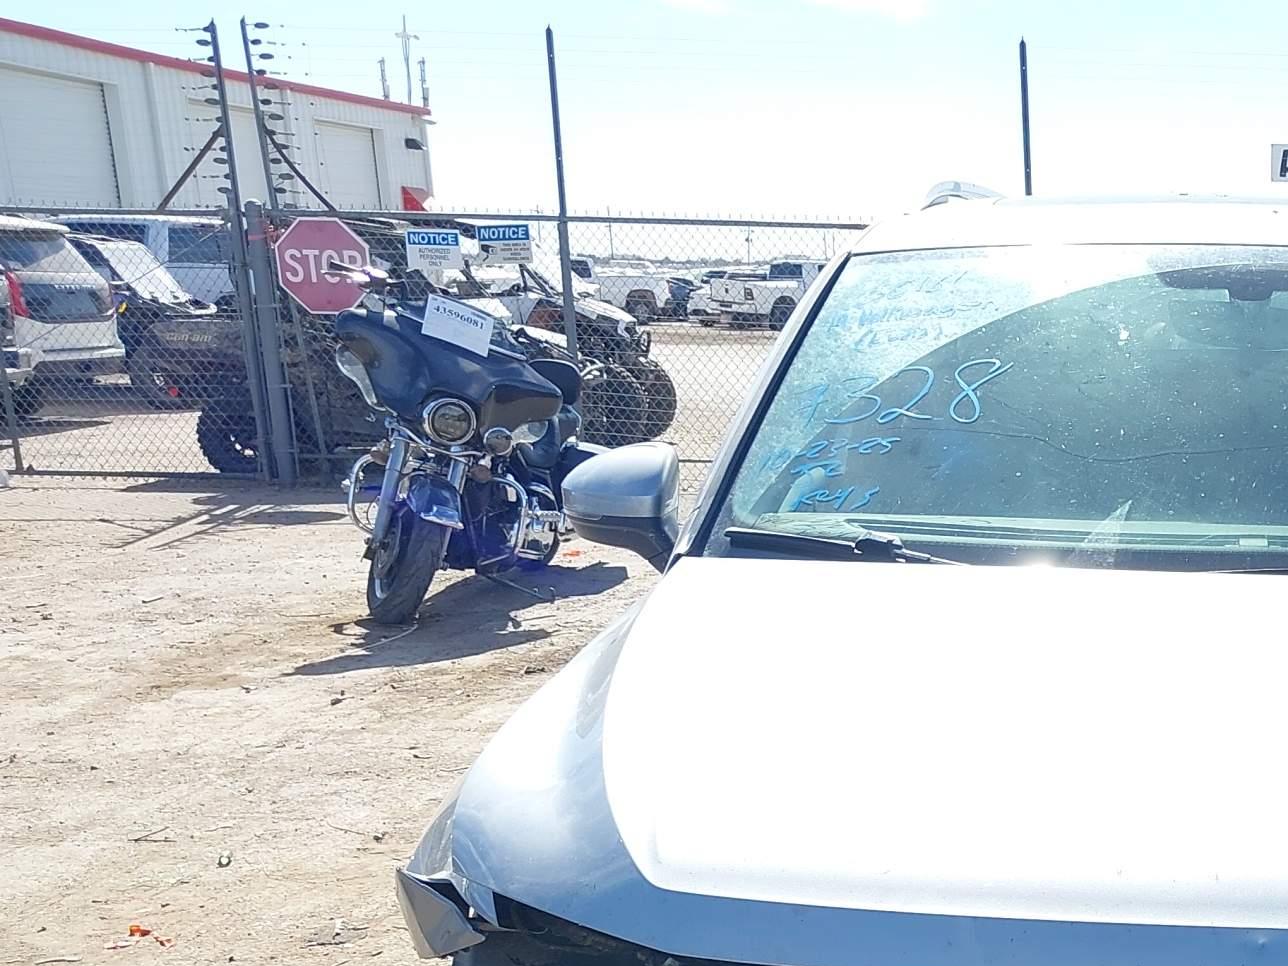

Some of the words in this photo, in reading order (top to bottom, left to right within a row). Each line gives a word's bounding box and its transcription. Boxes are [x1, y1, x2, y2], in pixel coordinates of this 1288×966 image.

[409, 233, 457, 245] NOTICE
[480, 227, 527, 239] NOTICE
[284, 249, 363, 283] STOP
[433, 305, 484, 330] 43596081
